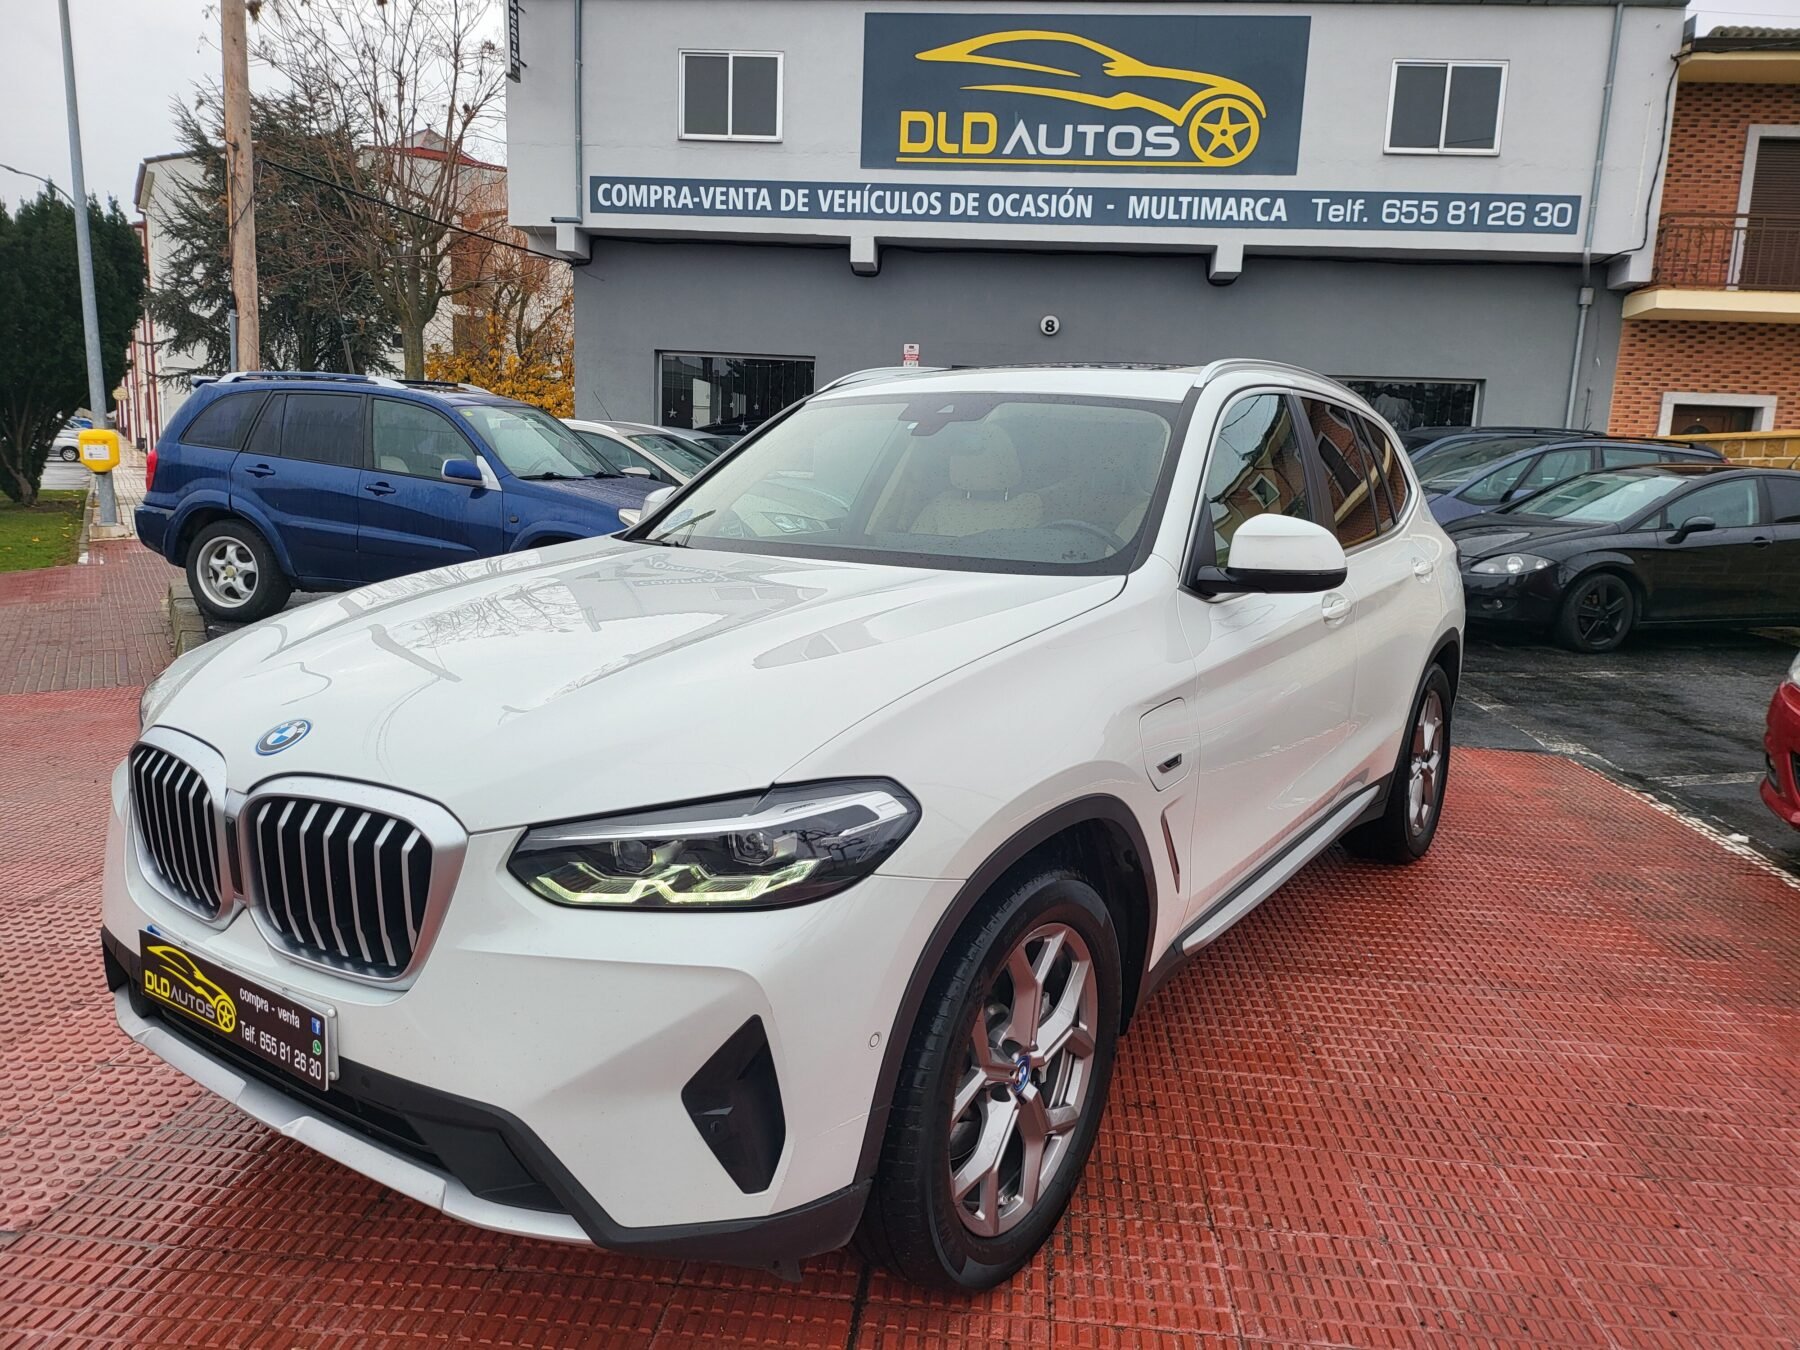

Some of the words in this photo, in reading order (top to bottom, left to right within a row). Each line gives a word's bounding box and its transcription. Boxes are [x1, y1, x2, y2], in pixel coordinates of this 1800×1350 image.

[900, 111, 998, 154] DLD
[1002, 119, 1180, 157] AUTOS
[597, 183, 772, 211] COMPRA-VENTA
[780, 188, 809, 212] DE
[818, 184, 942, 216] VEHÍCULOS
[949, 192, 980, 216] DE
[987, 188, 1093, 218] OCASIÓN
[1127, 195, 1288, 222] MULTIMARCA
[1311, 198, 1368, 223] Telf.
[1381, 199, 1439, 225] 655
[1446, 201, 1481, 225] 81
[1487, 201, 1527, 227] 26
[1533, 203, 1573, 228] 30
[1045, 319, 1055, 332] 8
[145, 970, 170, 998] DLD
[170, 985, 215, 1019] AUTOS
[240, 987, 269, 1012] compra
[277, 1006, 300, 1029] venta
[240, 1021, 257, 1045] Telf.
[259, 1031, 278, 1056] 655
[279, 1039, 291, 1064] 81
[294, 1049, 307, 1073] 26
[308, 1057, 322, 1081] 30
